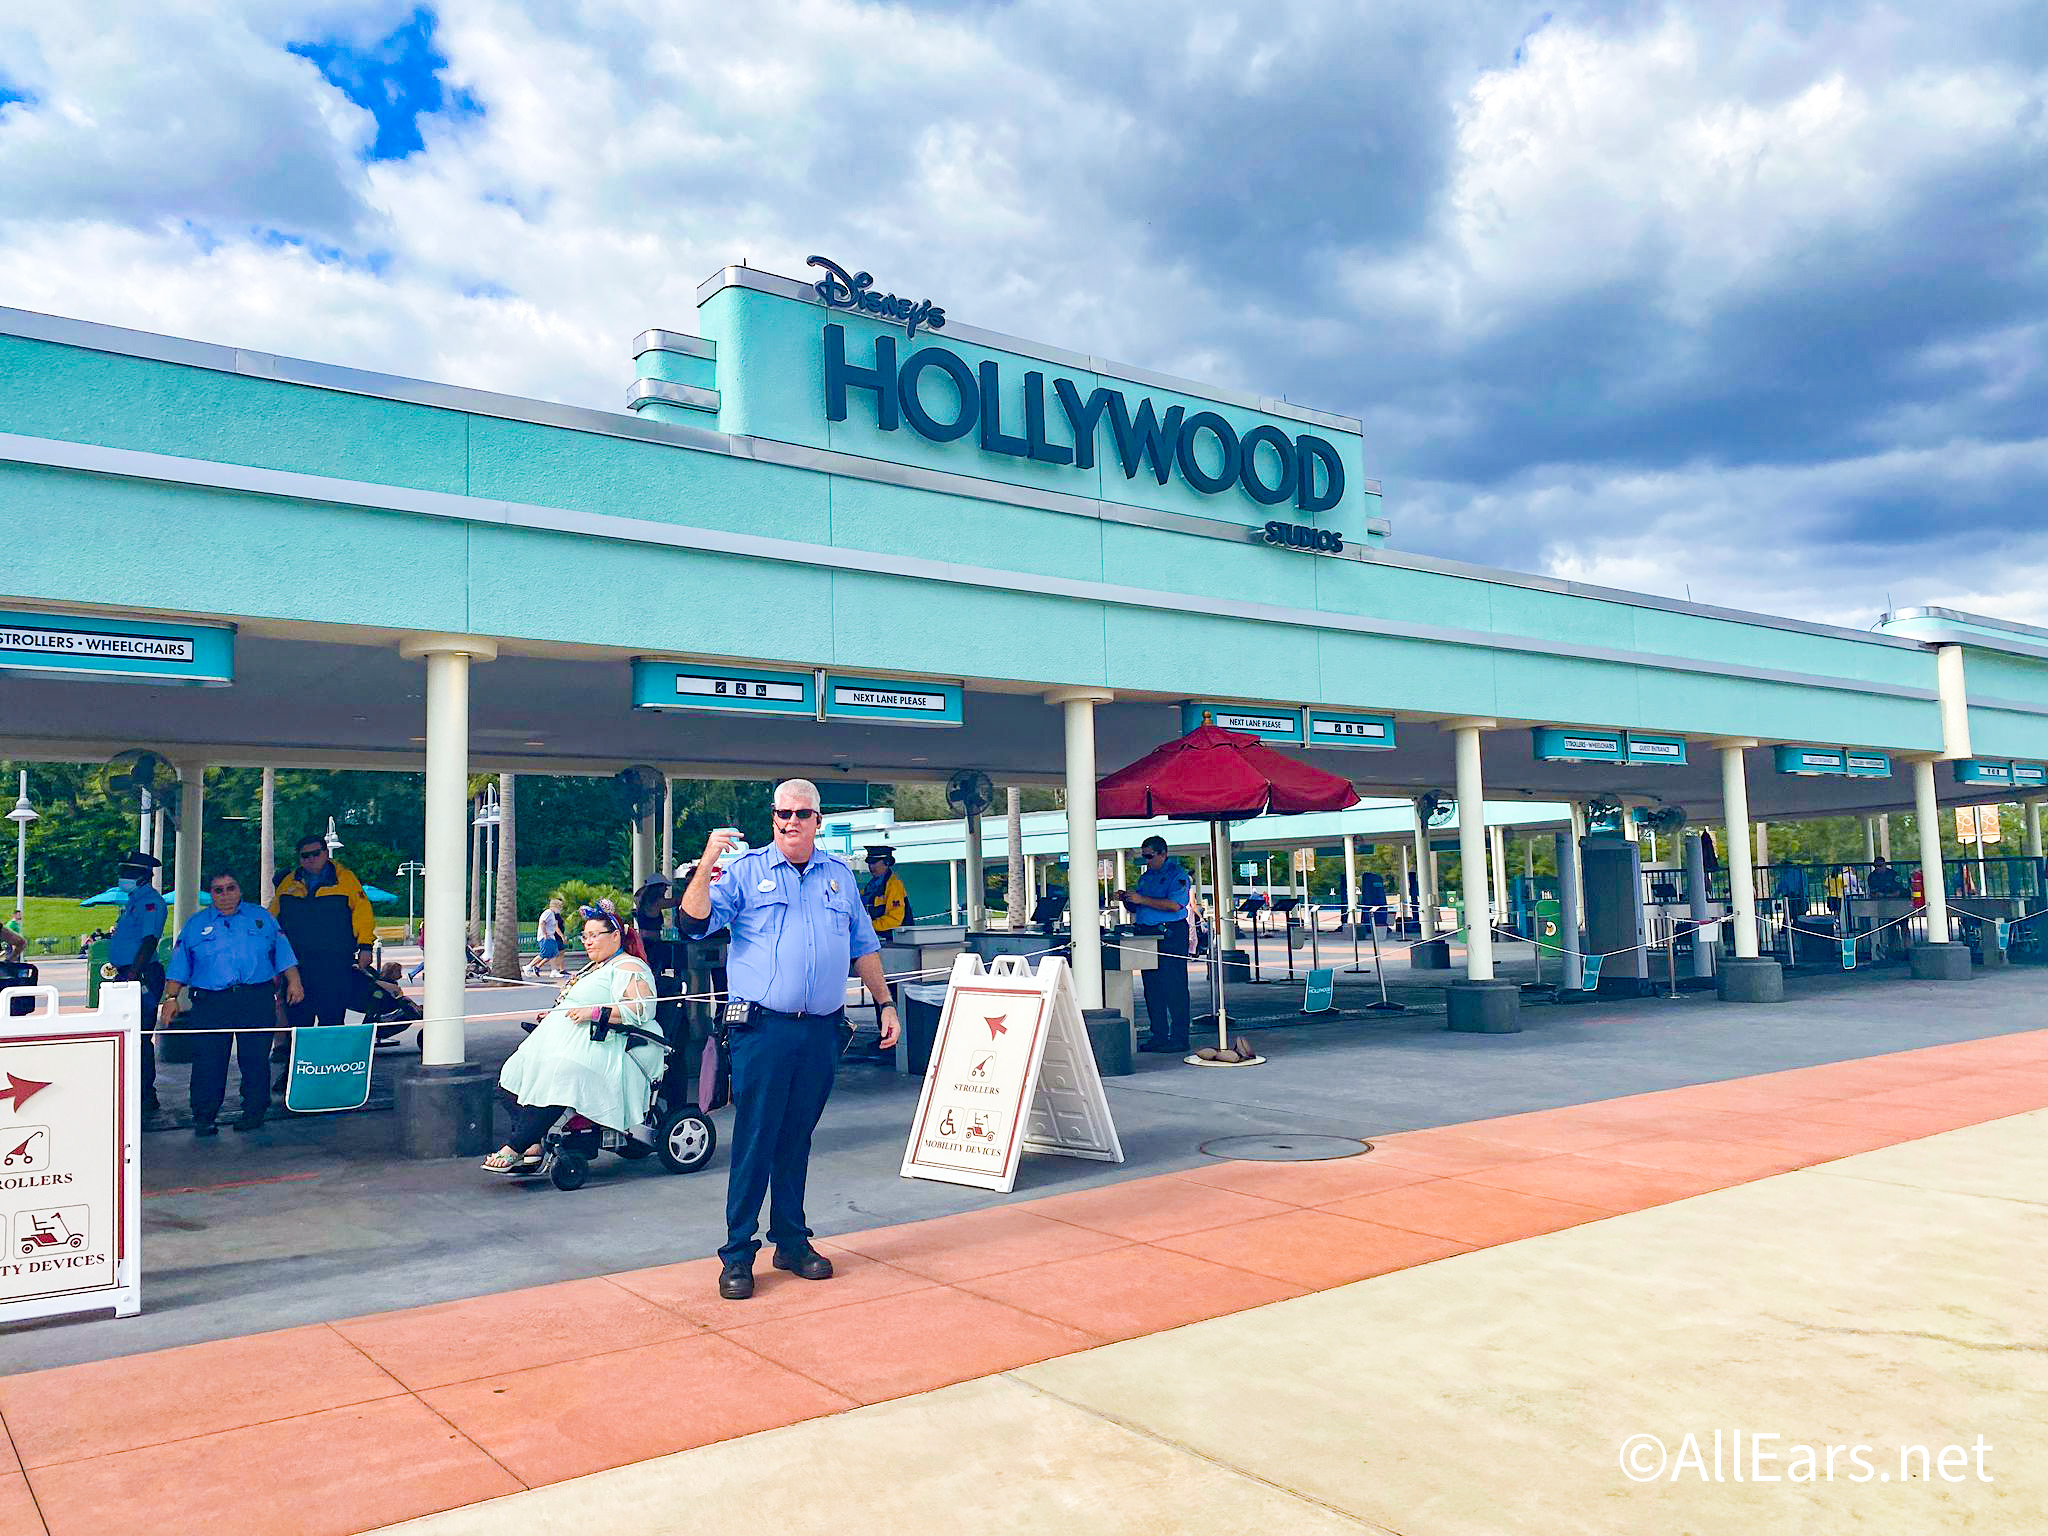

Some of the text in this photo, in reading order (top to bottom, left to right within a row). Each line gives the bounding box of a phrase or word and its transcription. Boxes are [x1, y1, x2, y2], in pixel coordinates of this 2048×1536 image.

[823, 323, 1345, 512] HOLLYWOOD
[1264, 521, 1343, 553] STUDIOS
[86, 638, 185, 656] WHEELCHAIRS
[853, 693, 927, 706] NEXT LANE PLEASE
[1229, 718, 1281, 729] NEXT LANE PLEASE
[296, 1061, 366, 1075] HOLLYWOOD
[953, 1083, 1000, 1096] STROLLERS
[925, 1139, 1001, 1157] MOBILITY DEVICES
[29, 1253, 105, 1273] DEVICES
